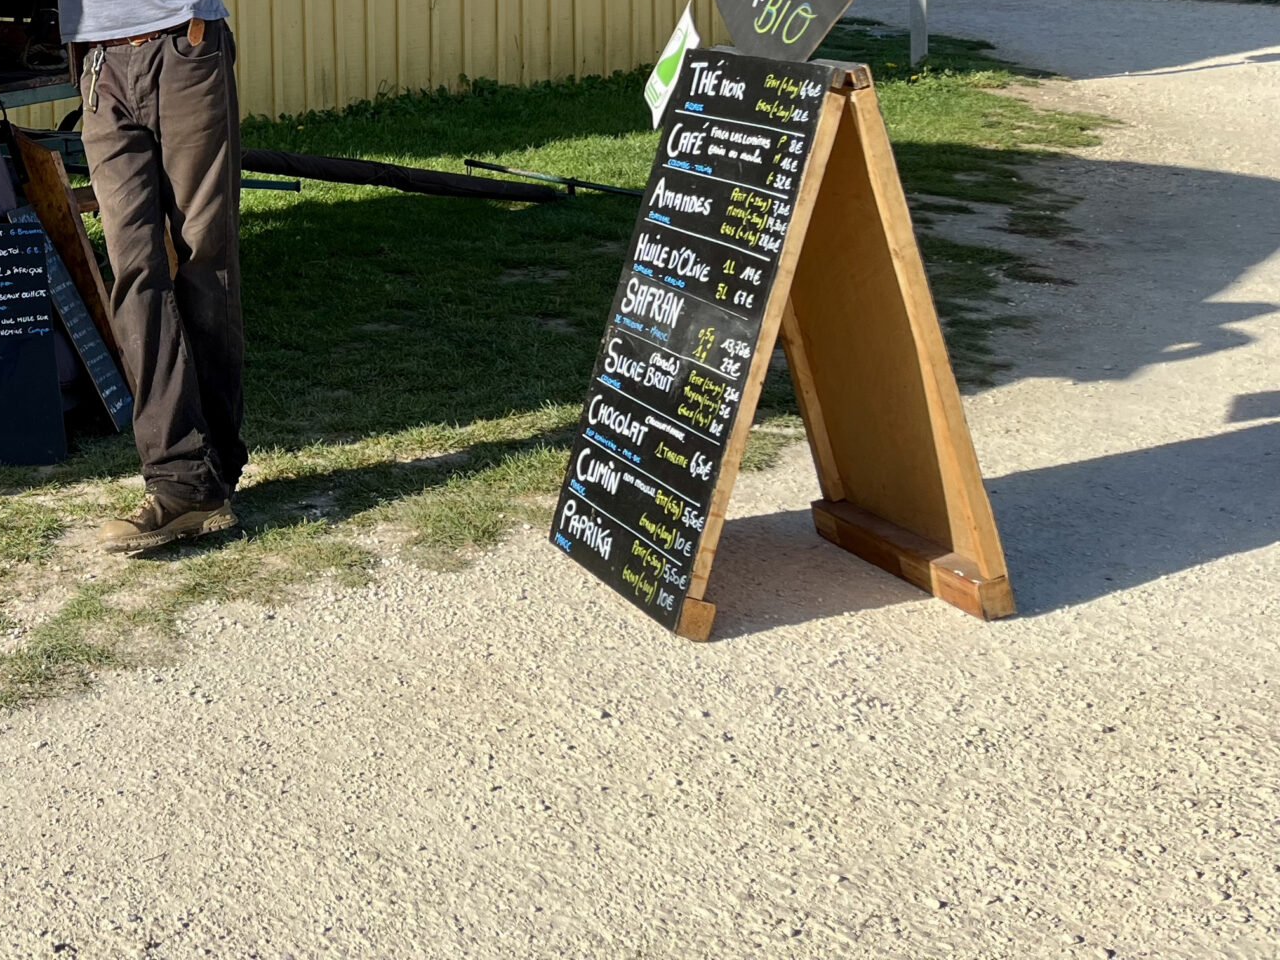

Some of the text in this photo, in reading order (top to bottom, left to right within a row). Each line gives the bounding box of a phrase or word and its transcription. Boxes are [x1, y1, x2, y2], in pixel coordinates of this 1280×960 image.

[689, 59, 724, 96] THÉ
[666, 121, 711, 158] CAFÉ
[788, 141, 804, 155] 8€
[648, 177, 714, 216] AMANDES
[773, 173, 792, 190] 32€
[739, 265, 763, 285] 14€
[620, 276, 685, 329] SAFRAN
[715, 283, 755, 309] 5L 67€
[604, 338, 646, 383] SUCRE
[643, 367, 676, 393] BRUT
[719, 358, 741, 377] 27€
[588, 394, 649, 446] CHOCOLAT
[576, 447, 621, 496] CUMIN
[559, 499, 614, 561] PAPRIKA
[656, 588, 675, 611] 10€
